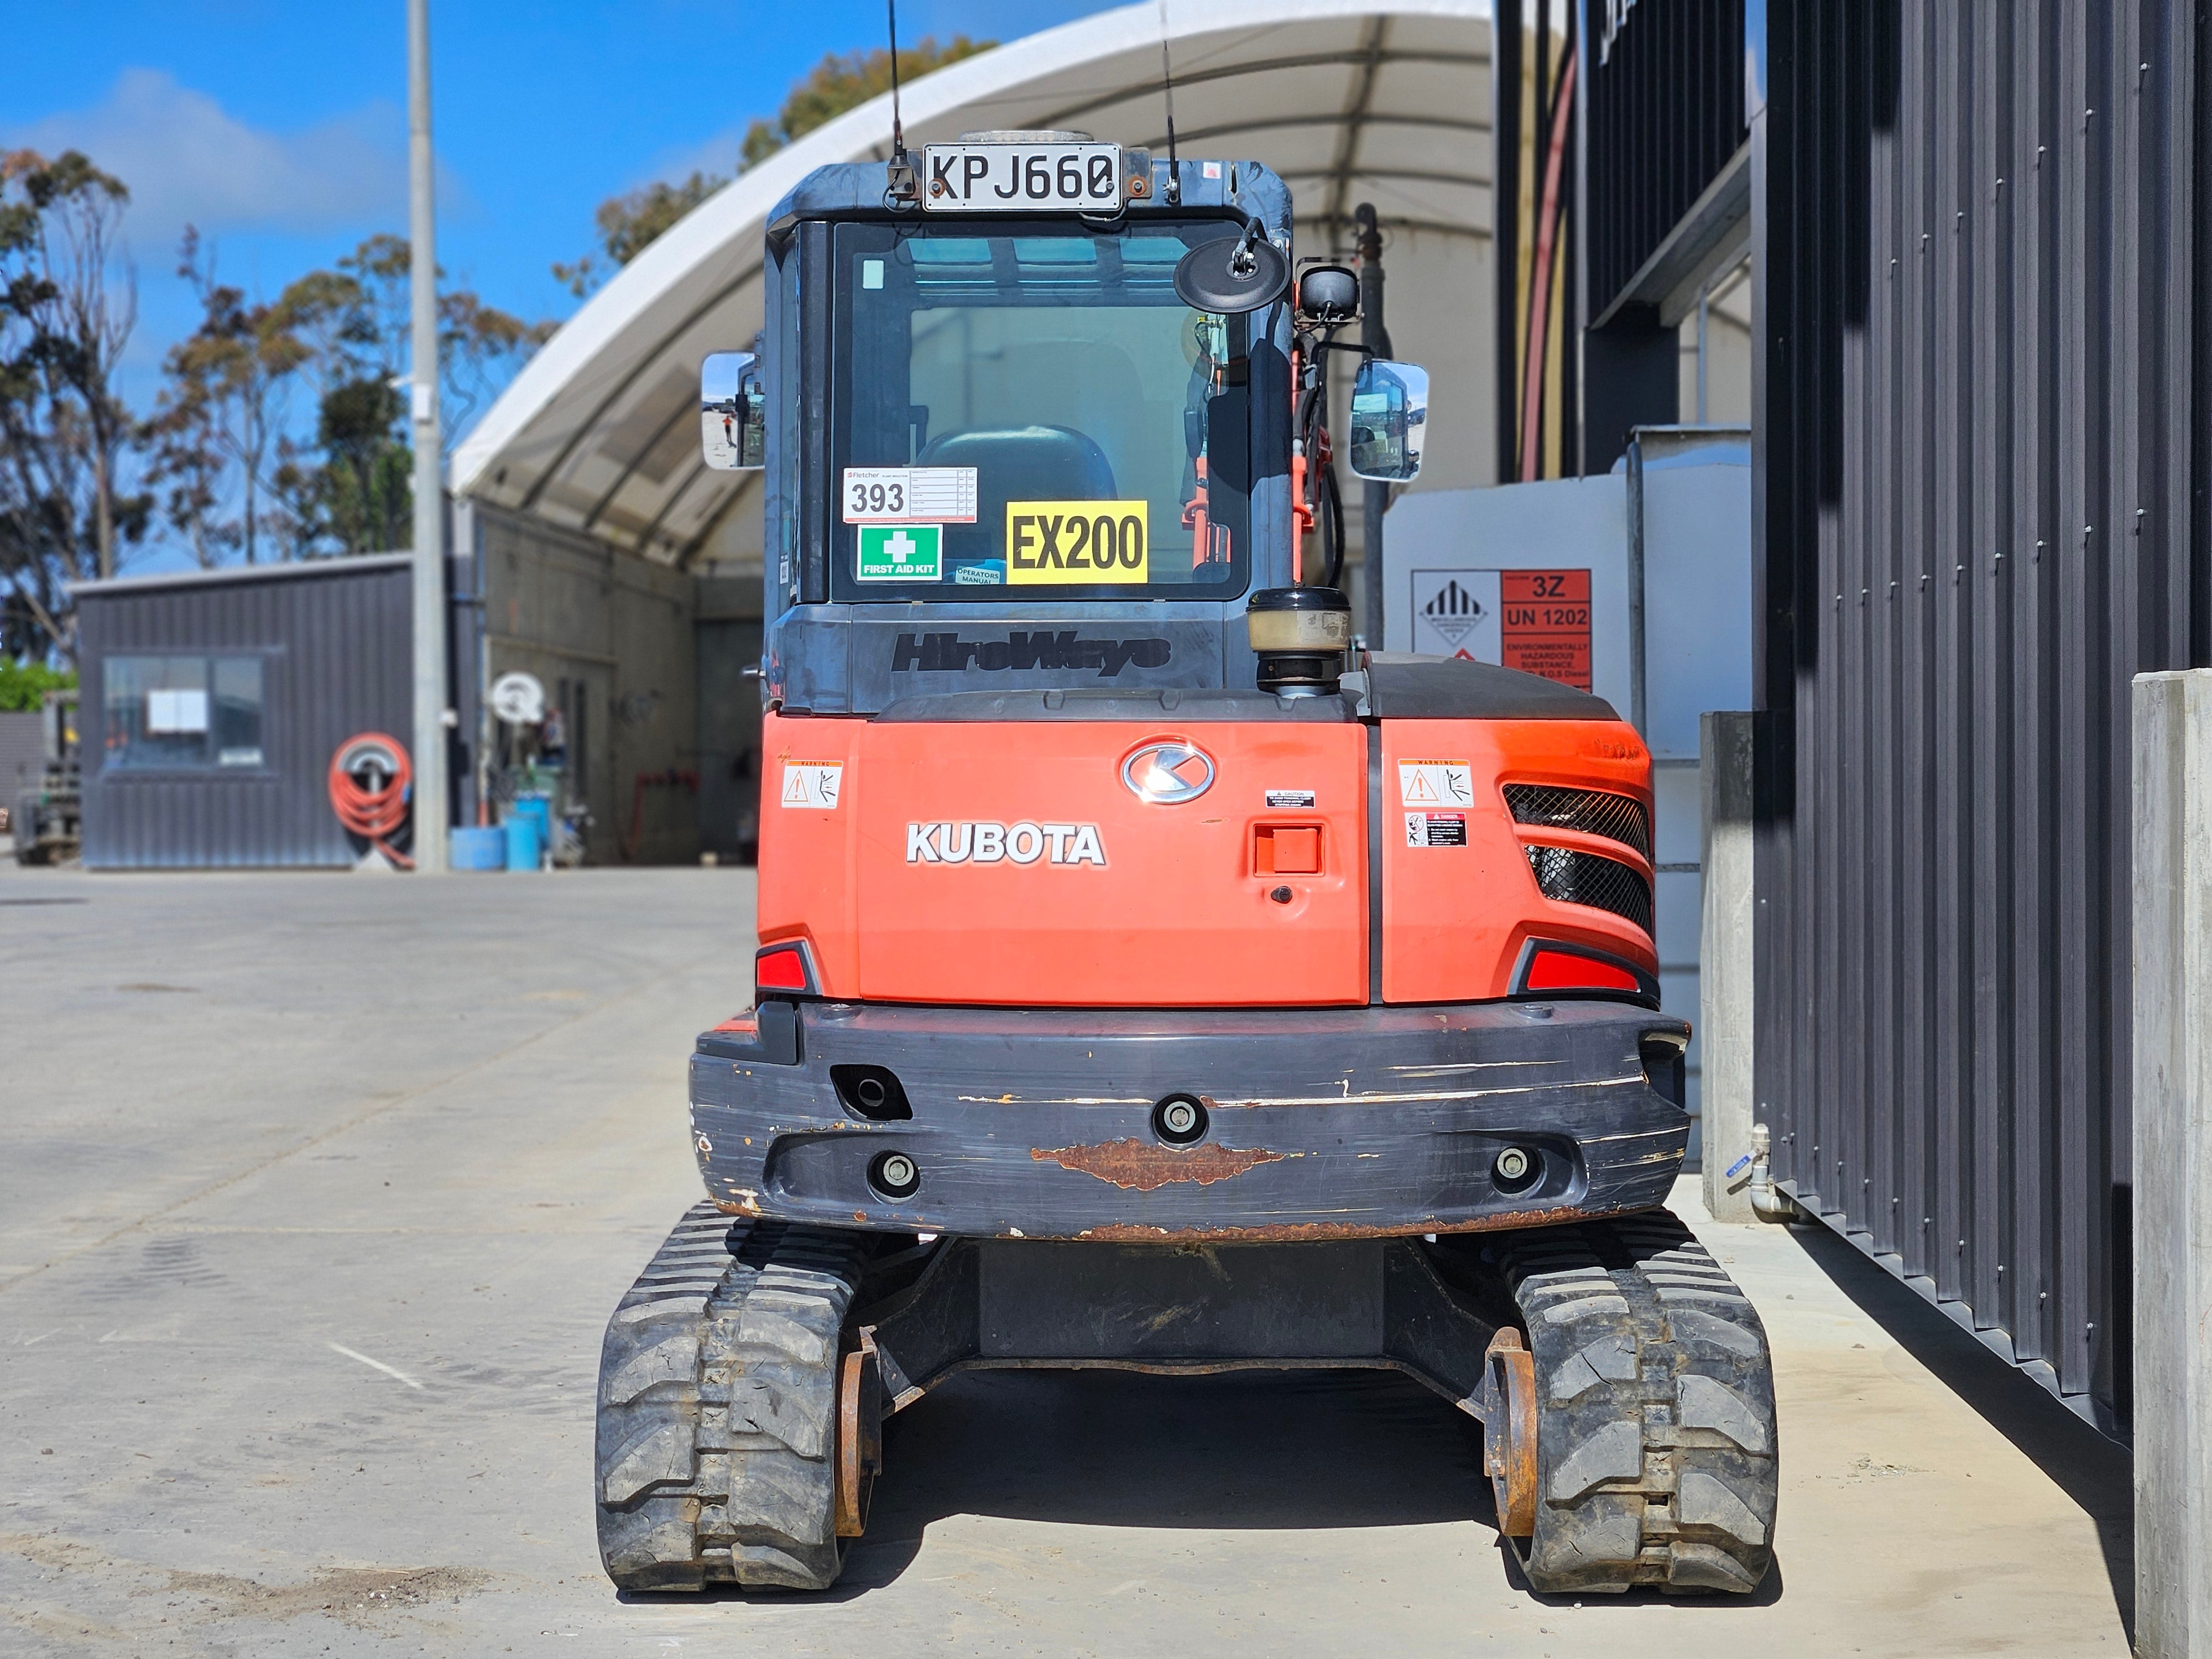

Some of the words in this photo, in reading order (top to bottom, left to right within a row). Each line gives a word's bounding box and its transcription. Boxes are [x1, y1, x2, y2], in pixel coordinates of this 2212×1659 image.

[933, 155, 1113, 199] KPJ660
[852, 484, 904, 512] 393
[1013, 515, 1143, 568] EX200
[864, 565, 894, 573] FIRST
[895, 565, 914, 573] AID
[917, 565, 935, 573] KIT
[958, 568, 999, 578] OPERATORS
[1532, 576, 1565, 597] 3Z
[1507, 609, 1536, 625] UN
[1543, 609, 1587, 625] 1202
[906, 822, 1105, 865] KUBOTA
